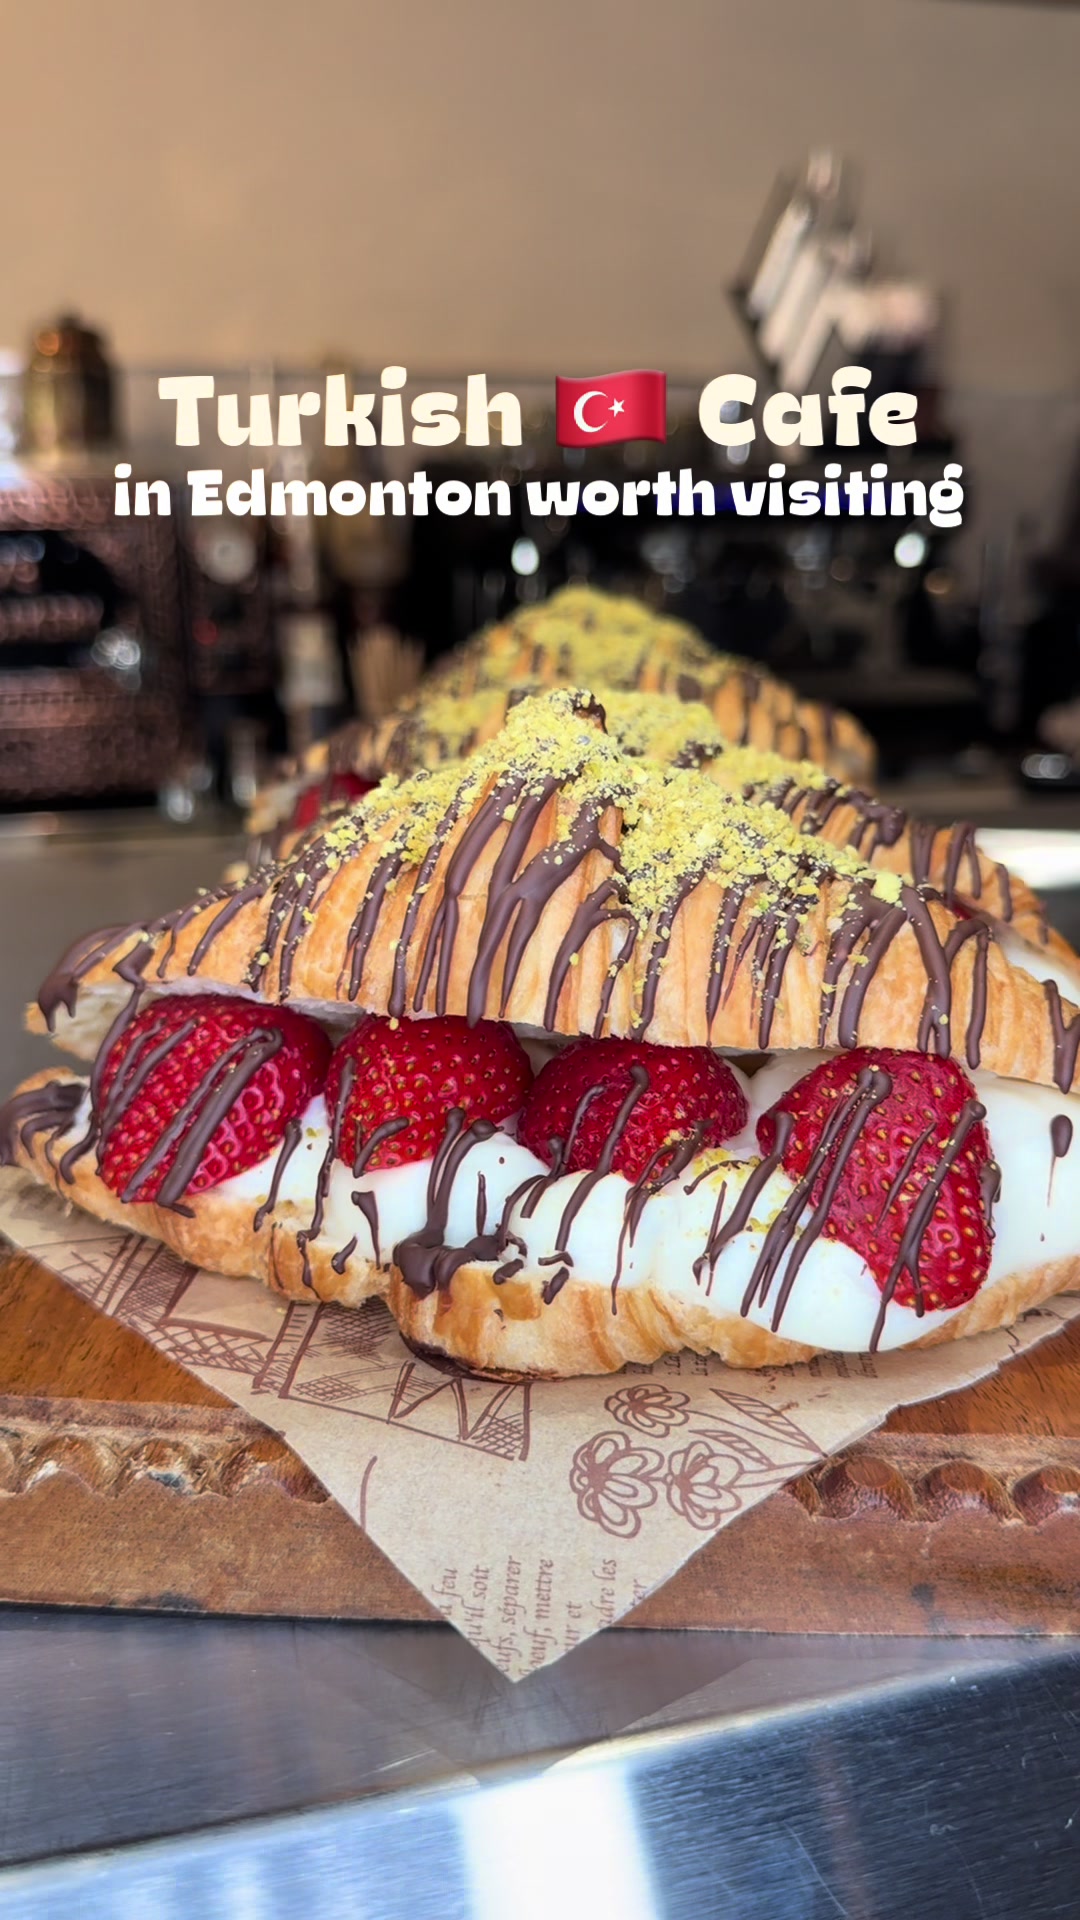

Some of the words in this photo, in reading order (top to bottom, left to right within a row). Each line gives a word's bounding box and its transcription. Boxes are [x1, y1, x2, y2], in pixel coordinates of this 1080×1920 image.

[431, 1568, 461, 1599] feu
[469, 1564, 490, 1599] soit
[591, 1558, 617, 1581] les
[497, 1555, 527, 1625] séparer
[535, 1558, 554, 1619] mettre
[565, 1600, 582, 1619] et
